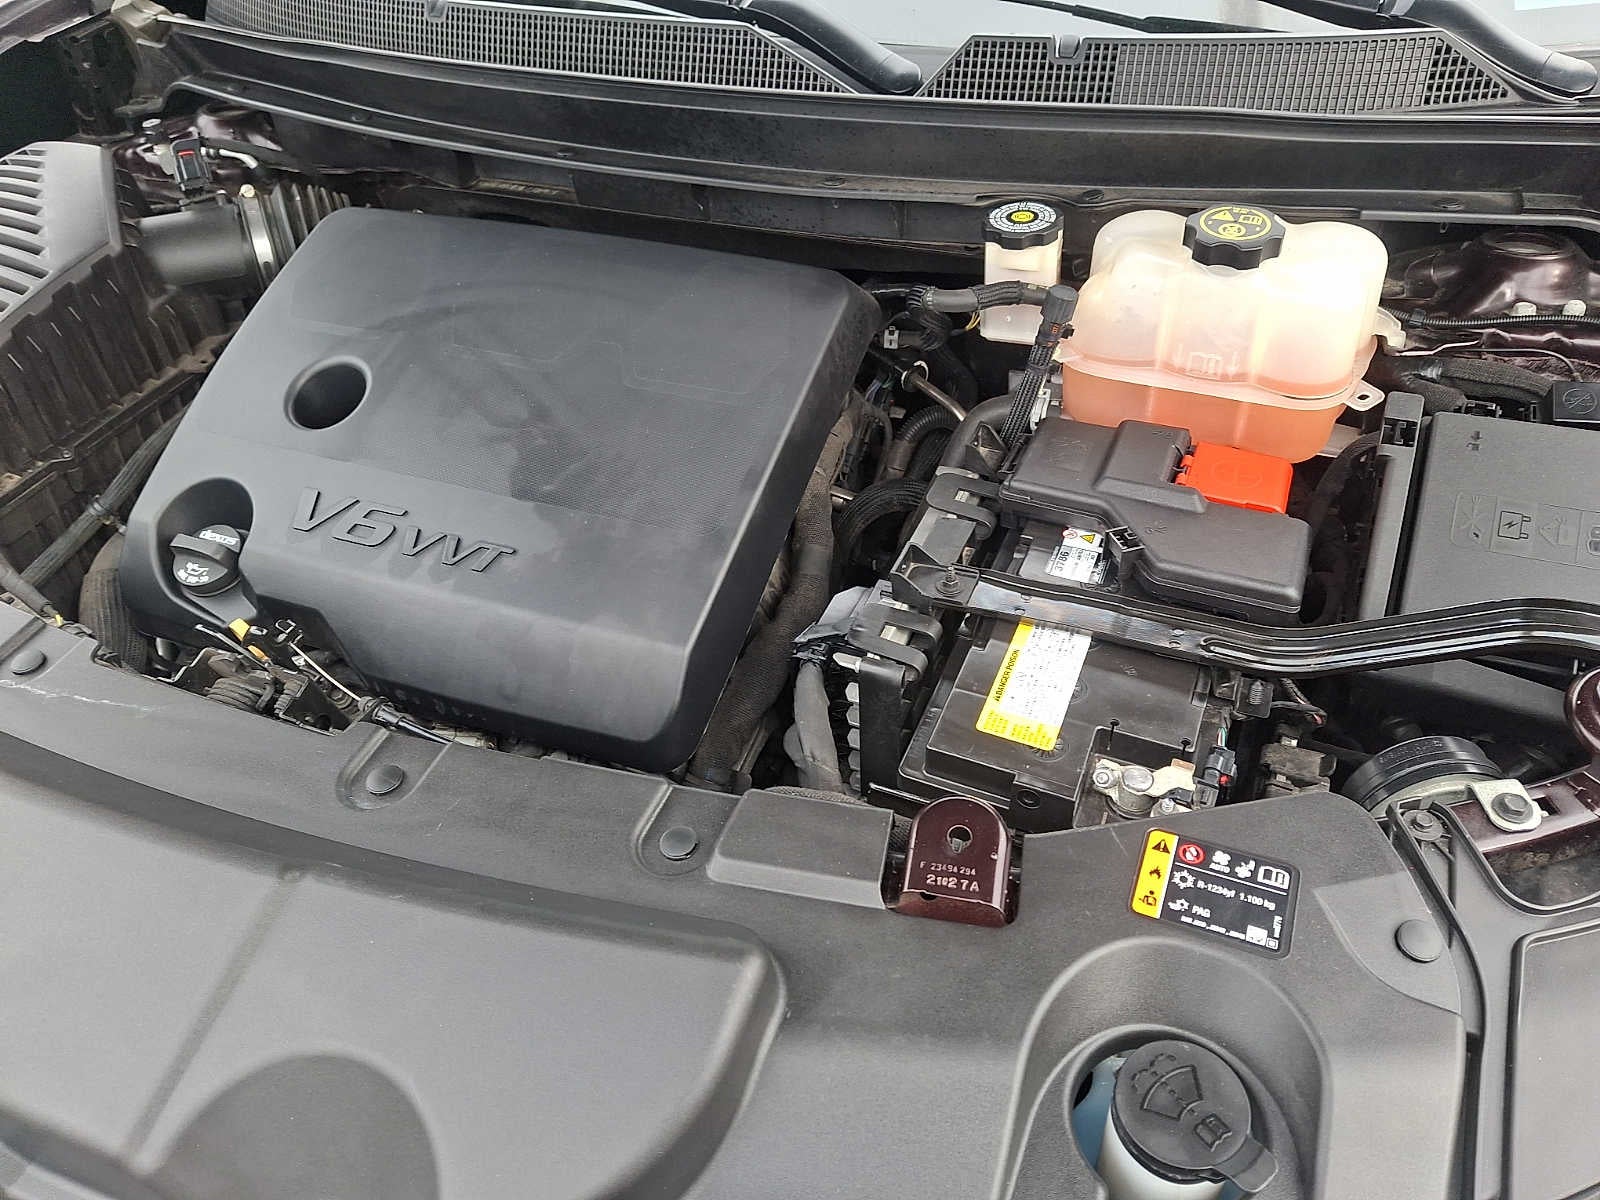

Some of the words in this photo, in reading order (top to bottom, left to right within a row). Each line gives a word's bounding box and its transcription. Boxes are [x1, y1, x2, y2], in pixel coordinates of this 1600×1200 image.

[292, 486, 409, 547] V6
[995, 671, 1011, 696] DANGER
[1005, 649, 1020, 671] POISON
[919, 861, 927, 869] F
[1208, 862, 1231, 874] AUTO
[1239, 892, 1264, 906] 1.100
[1263, 899, 1276, 911] kg
[1191, 904, 1211, 918] PAG
